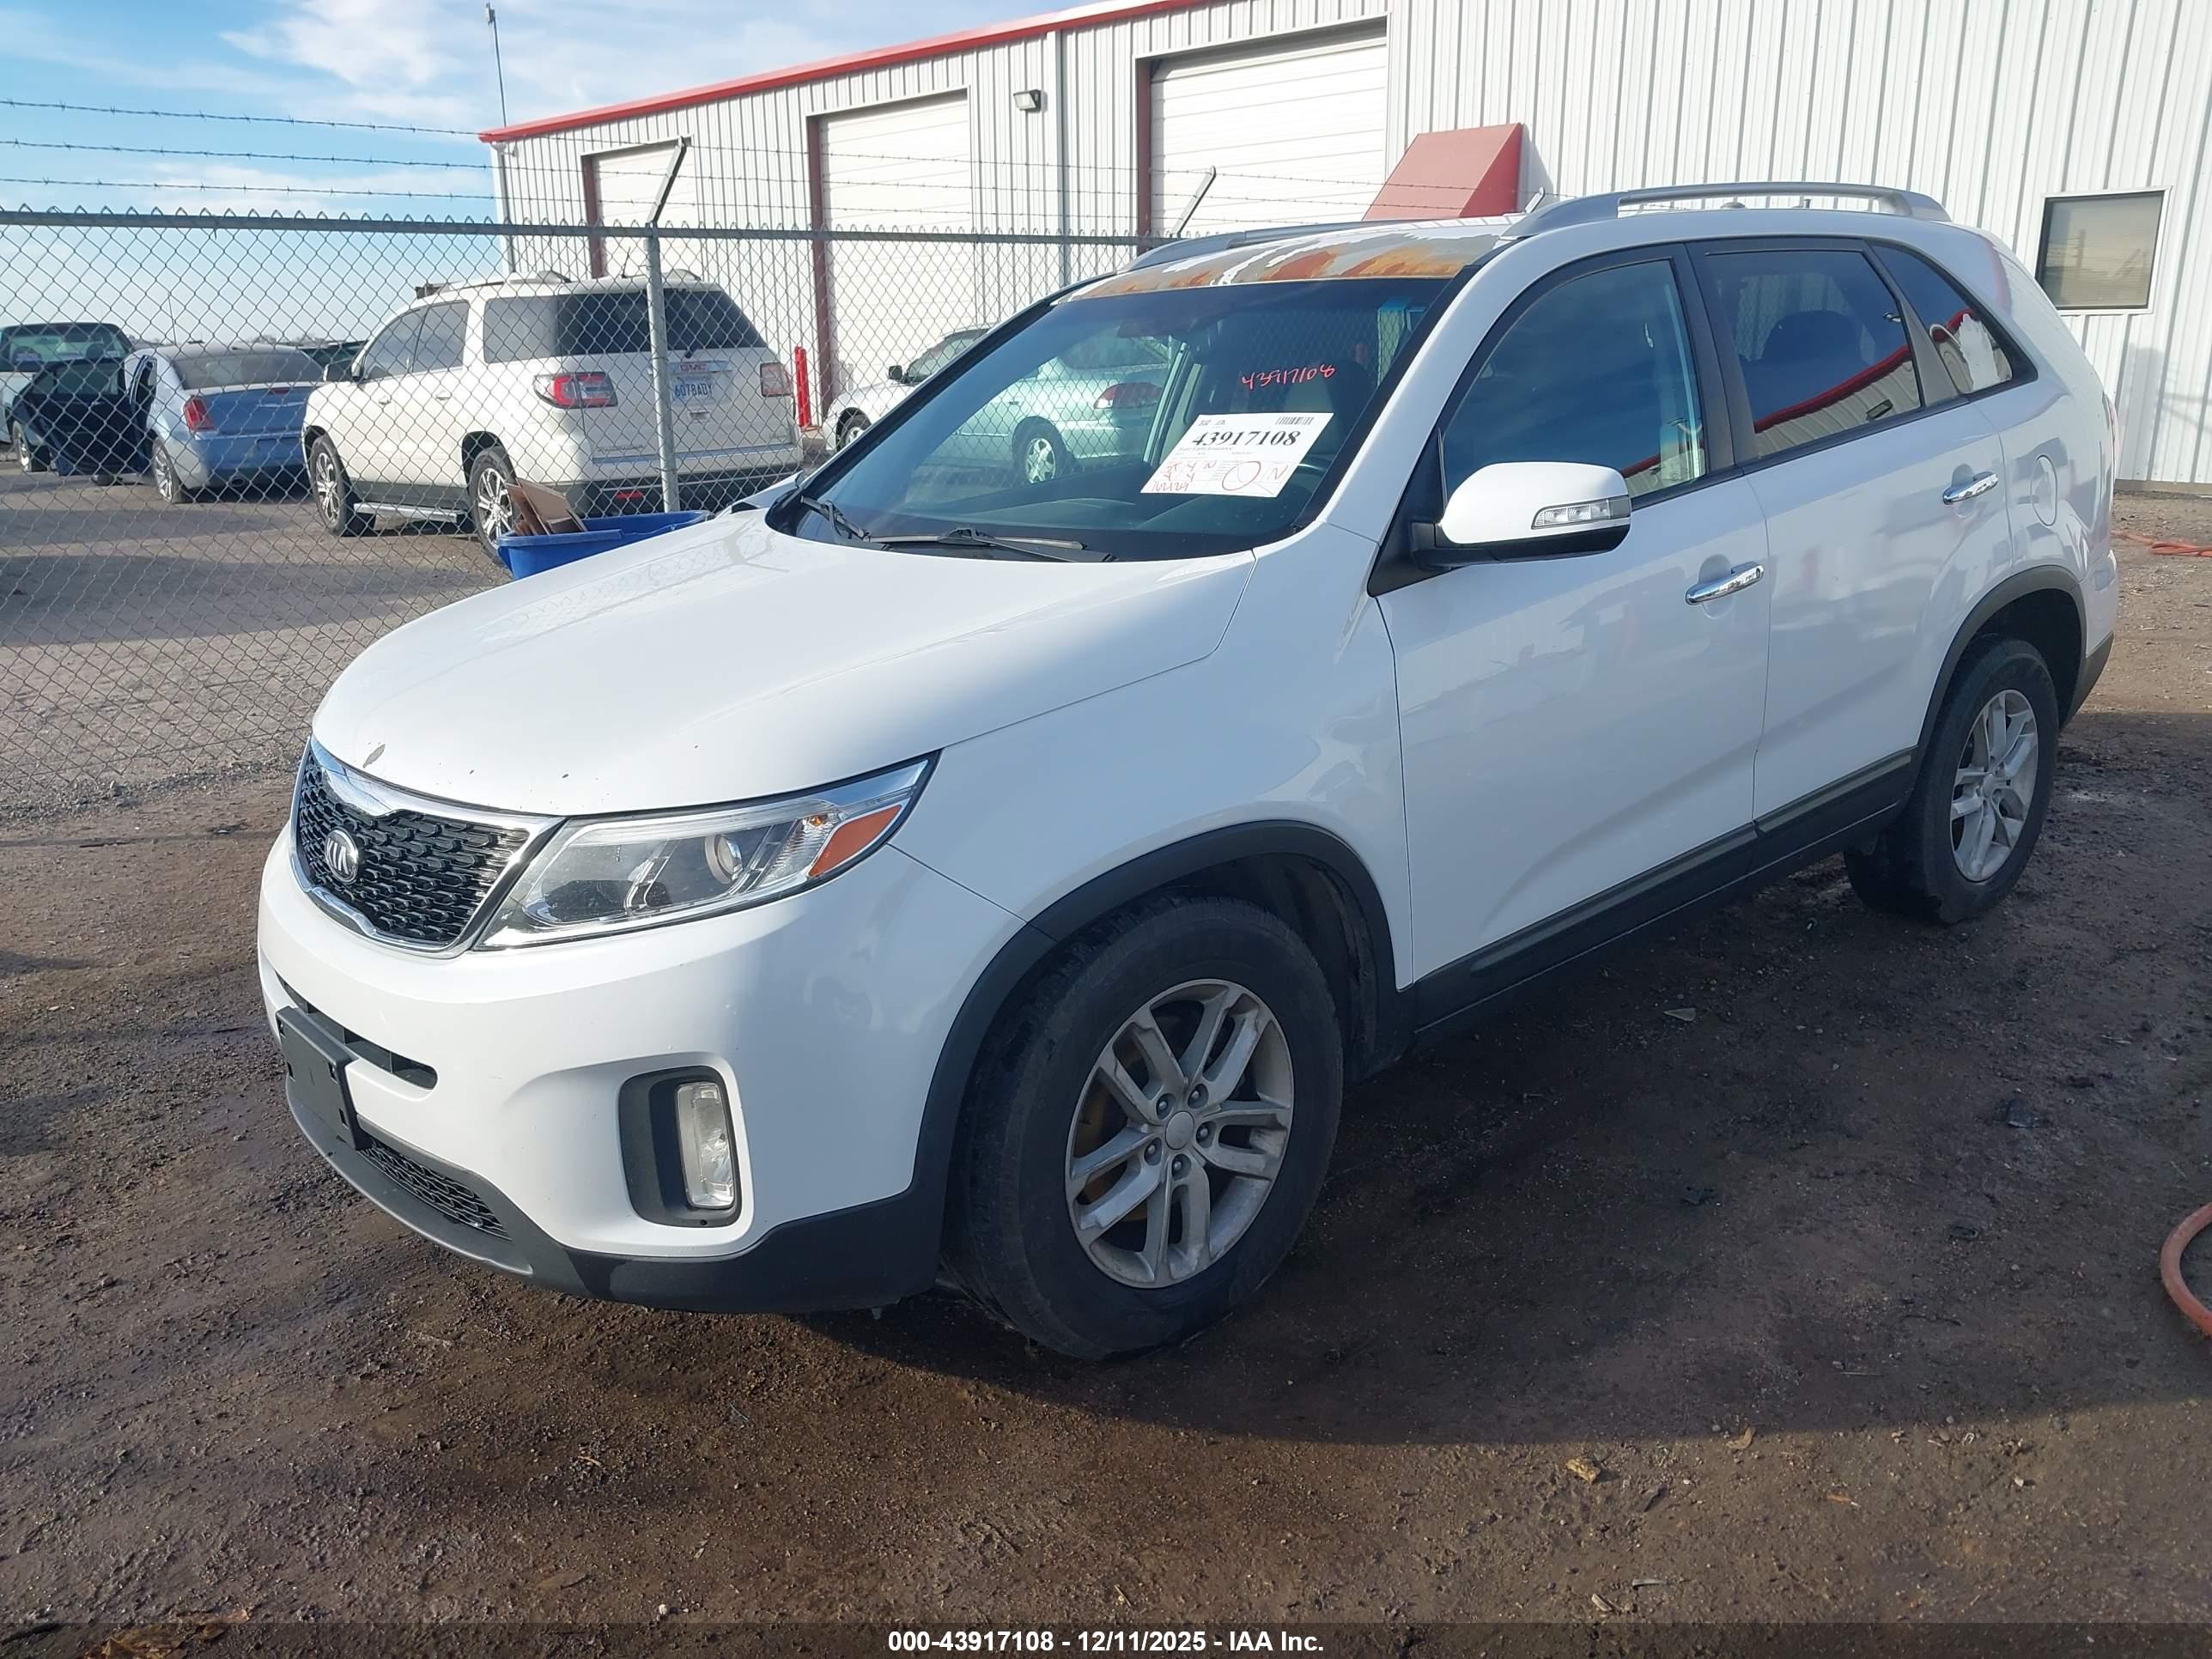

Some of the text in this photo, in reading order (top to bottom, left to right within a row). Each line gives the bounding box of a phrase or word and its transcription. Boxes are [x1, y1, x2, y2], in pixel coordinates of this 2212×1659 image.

[1242, 364, 1335, 390] 43917108
[1192, 430, 1301, 447] 43917108
[326, 837, 349, 875] KIA
